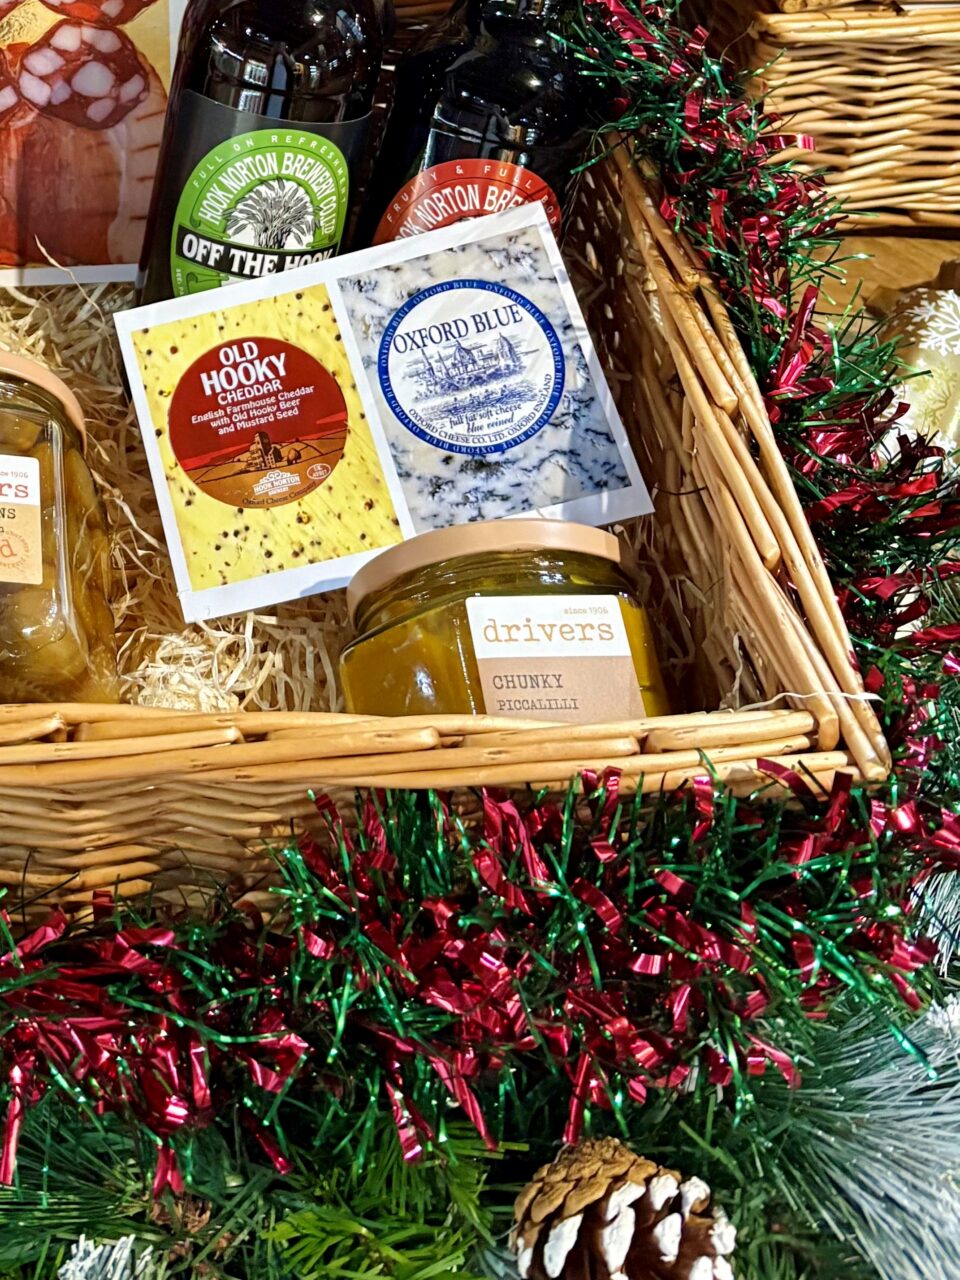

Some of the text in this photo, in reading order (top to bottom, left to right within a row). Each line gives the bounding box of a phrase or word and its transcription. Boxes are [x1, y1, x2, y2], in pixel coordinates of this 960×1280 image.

[193, 155, 223, 188] FULL
[233, 138, 255, 152] ON
[455, 165, 464, 175] &
[198, 152, 336, 225] HOOK NORTON BREWERY
[415, 184, 481, 227] NORTON
[182, 233, 279, 276] OFF THE
[393, 303, 524, 354] OXFORD BLUE
[219, 341, 259, 366] OLD
[200, 352, 288, 396] HOOKY
[191, 385, 315, 424] English Farmhouse Cheddar
[217, 379, 283, 406] CHEDDAR
[210, 397, 301, 429] with Old Hooky Beer
[217, 407, 300, 435] and Mustard Seed
[408, 407, 439, 434] OXFORD
[438, 431, 471, 444] CHEESE
[508, 411, 537, 437] OXFORD
[535, 373, 553, 413] ENGLAND
[494, 403, 523, 415] cheese
[563, 606, 588, 615] since
[483, 617, 615, 643] drivers
[492, 674, 564, 690] CHUNKY
[496, 697, 580, 712] PICCALILLI
